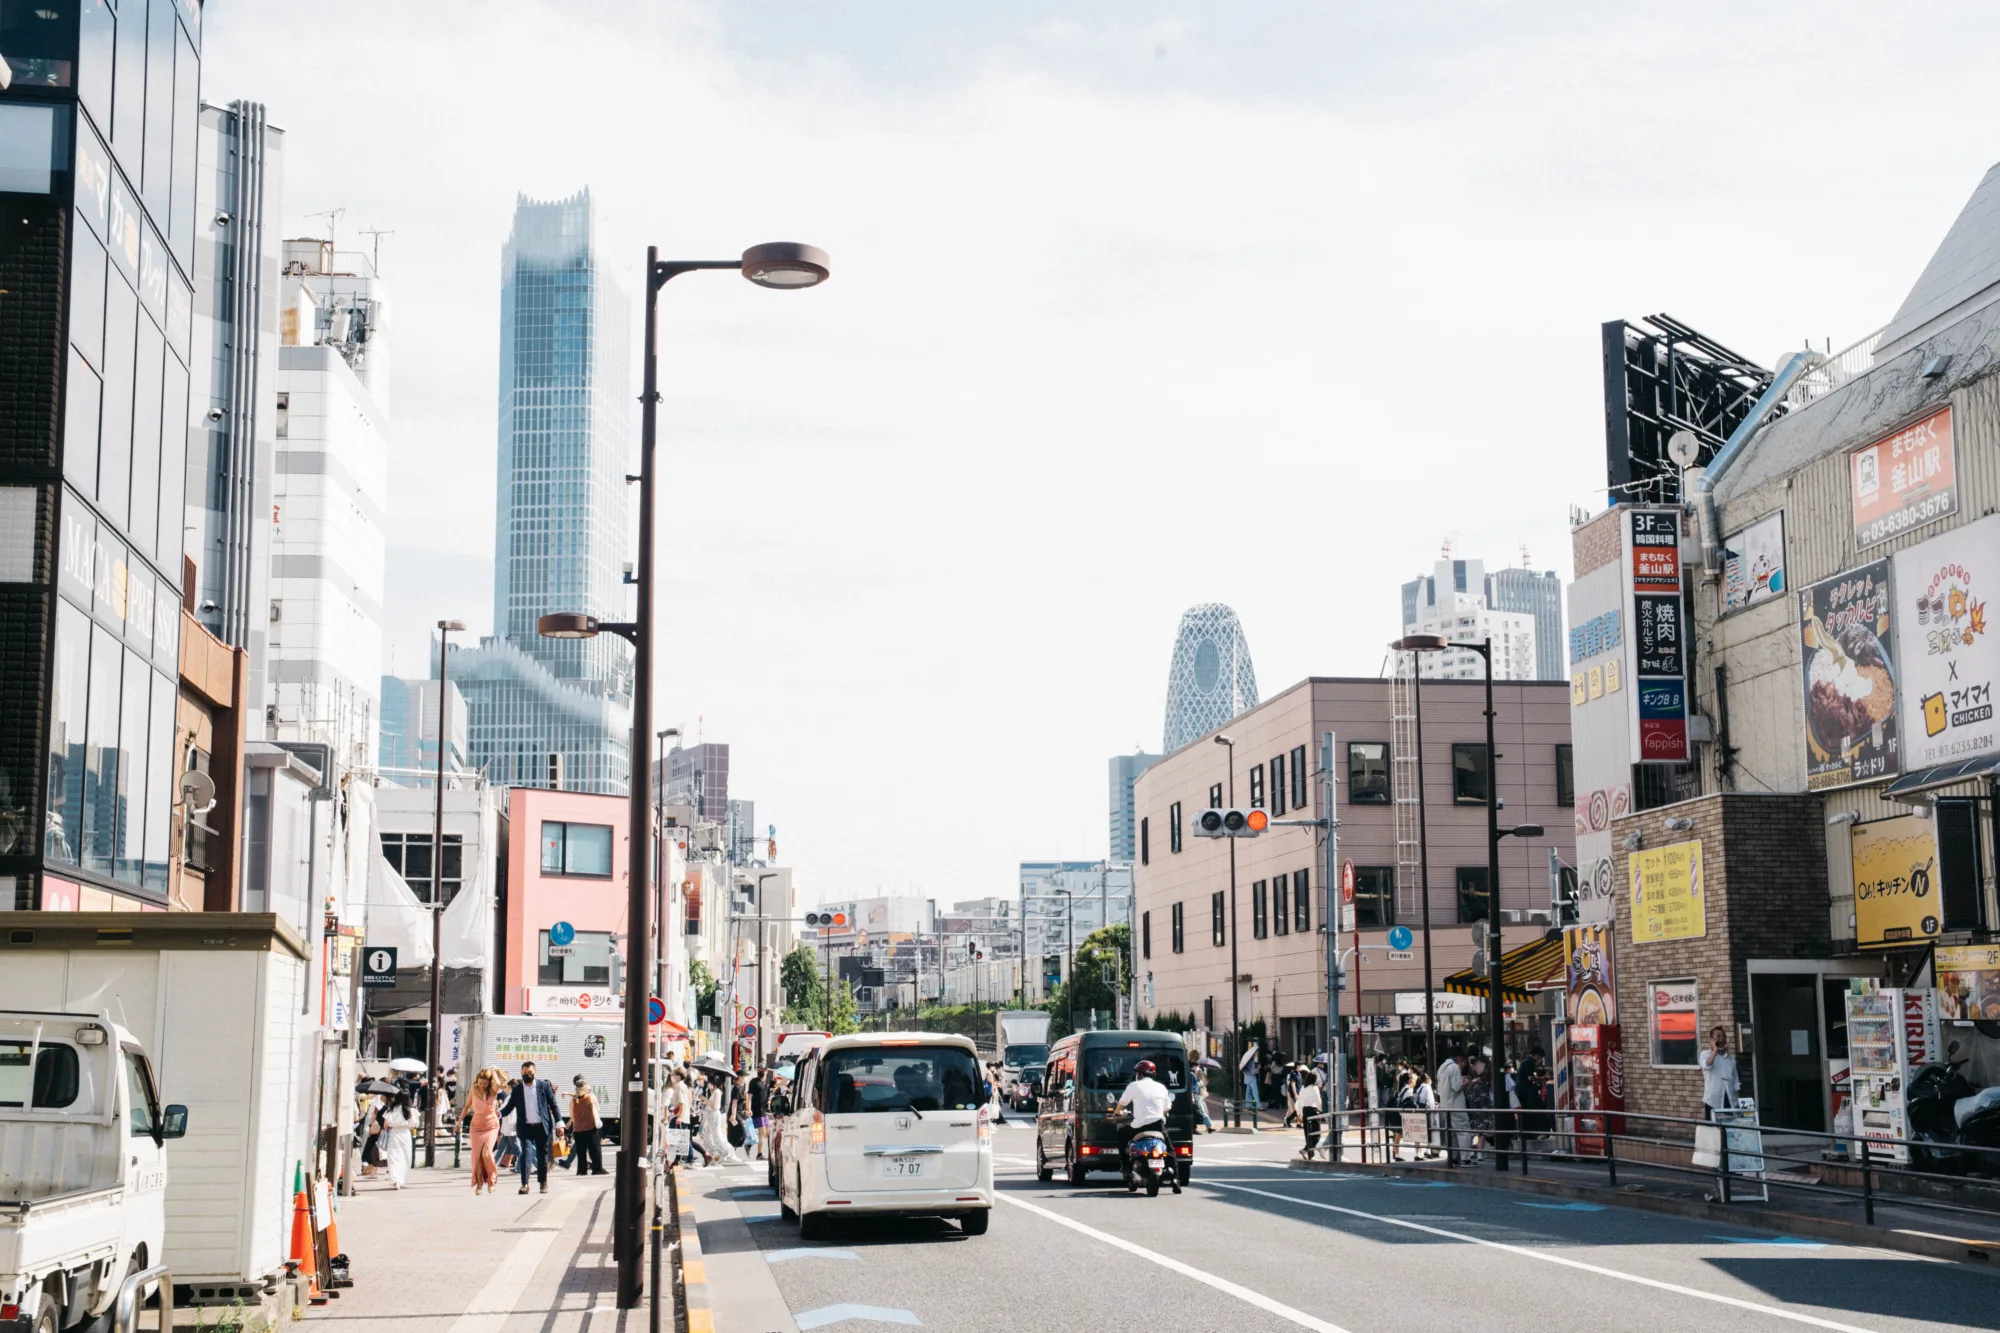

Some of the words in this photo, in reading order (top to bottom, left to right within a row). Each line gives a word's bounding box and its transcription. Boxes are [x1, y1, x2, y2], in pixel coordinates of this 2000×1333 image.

[1891, 417, 1937, 458] まもなく
[1891, 446, 1942, 493] 釜山駅
[1635, 515, 1655, 531] 3F
[1871, 491, 1950, 541] 03-6380-3676
[1635, 534, 1675, 545] 韓国料理
[1640, 552, 1672, 562] まもなく
[65, 514, 112, 607] MACA
[1639, 563, 1674, 575] 釜山駅
[1830, 574, 1873, 609] ラクレット
[1641, 600, 1653, 654] 炭火ホルモン
[1656, 604, 1676, 641] 焼肉
[1825, 596, 1877, 635] タッカルビ
[1951, 681, 1990, 709] マイマイ
[1926, 920, 1935, 932] 1F
[1987, 951, 1999, 965] 2F
[1904, 995, 1927, 1066] KIRIN
